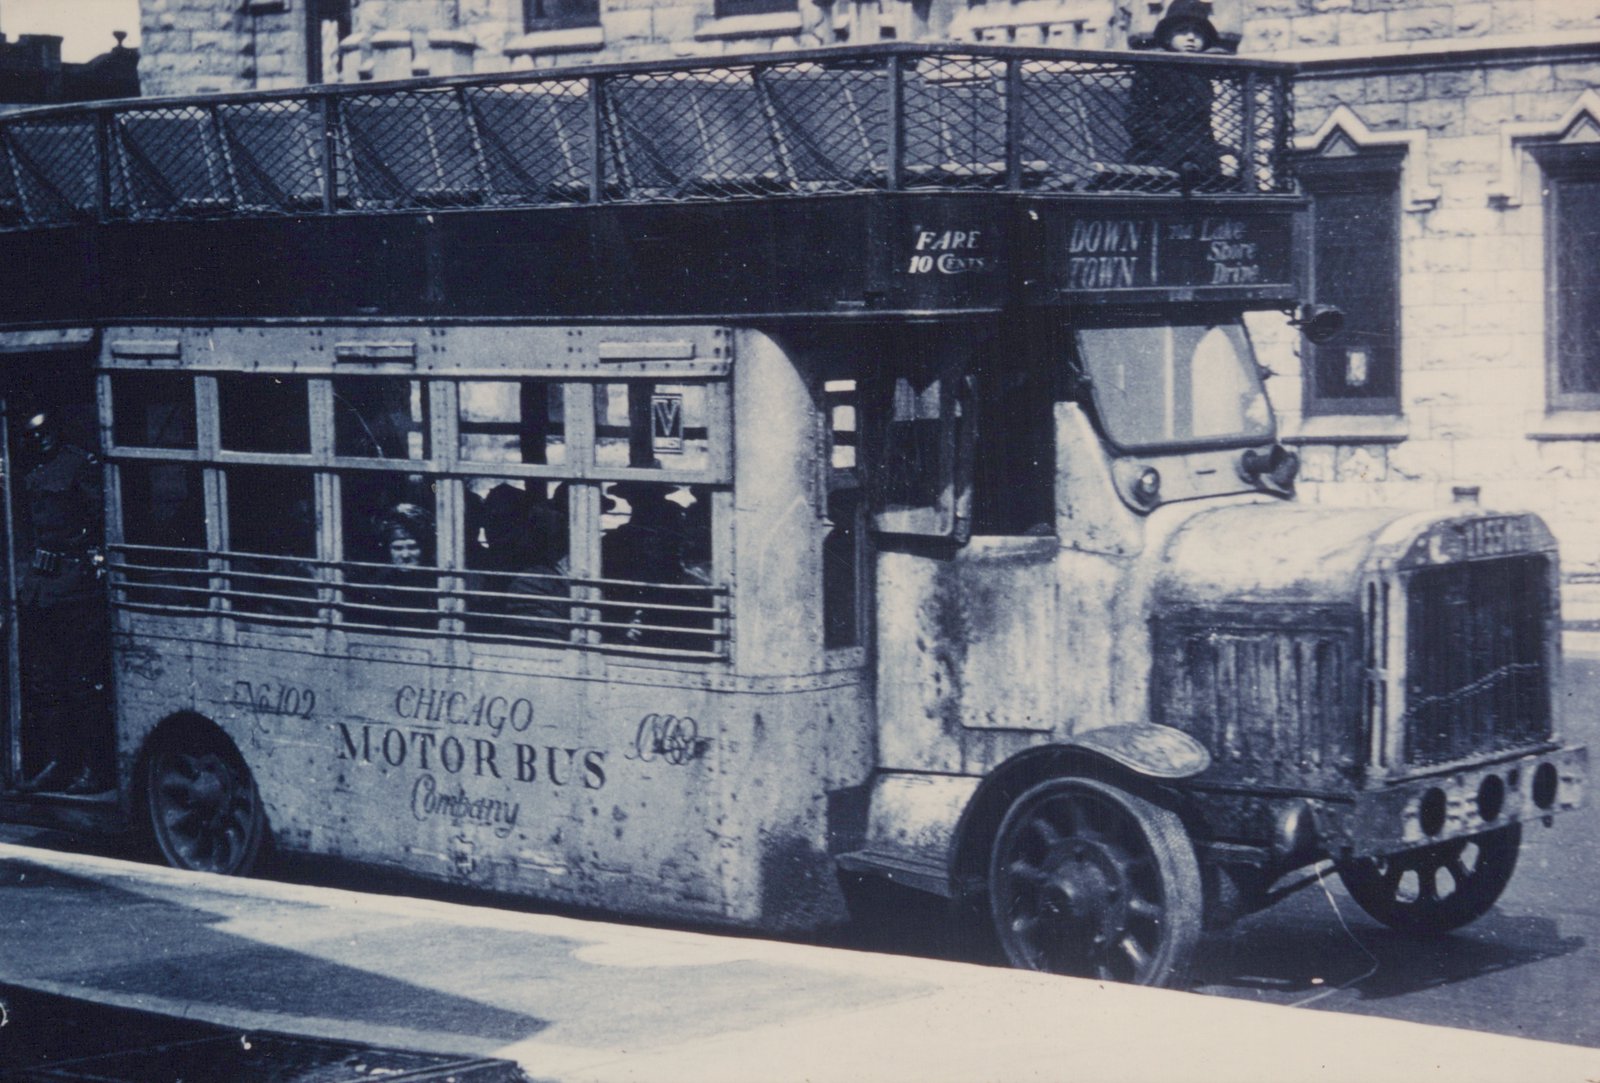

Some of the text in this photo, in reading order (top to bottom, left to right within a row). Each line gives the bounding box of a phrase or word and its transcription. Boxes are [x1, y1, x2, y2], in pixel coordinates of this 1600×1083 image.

[915, 230, 981, 250] FARE
[1069, 219, 1142, 253] DOWN
[908, 255, 934, 274] 10
[1069, 256, 1138, 289] TOWN
[395, 685, 534, 738] CHICAGO
[337, 722, 608, 790] MOTOR BUS
[410, 773, 520, 838] Company
